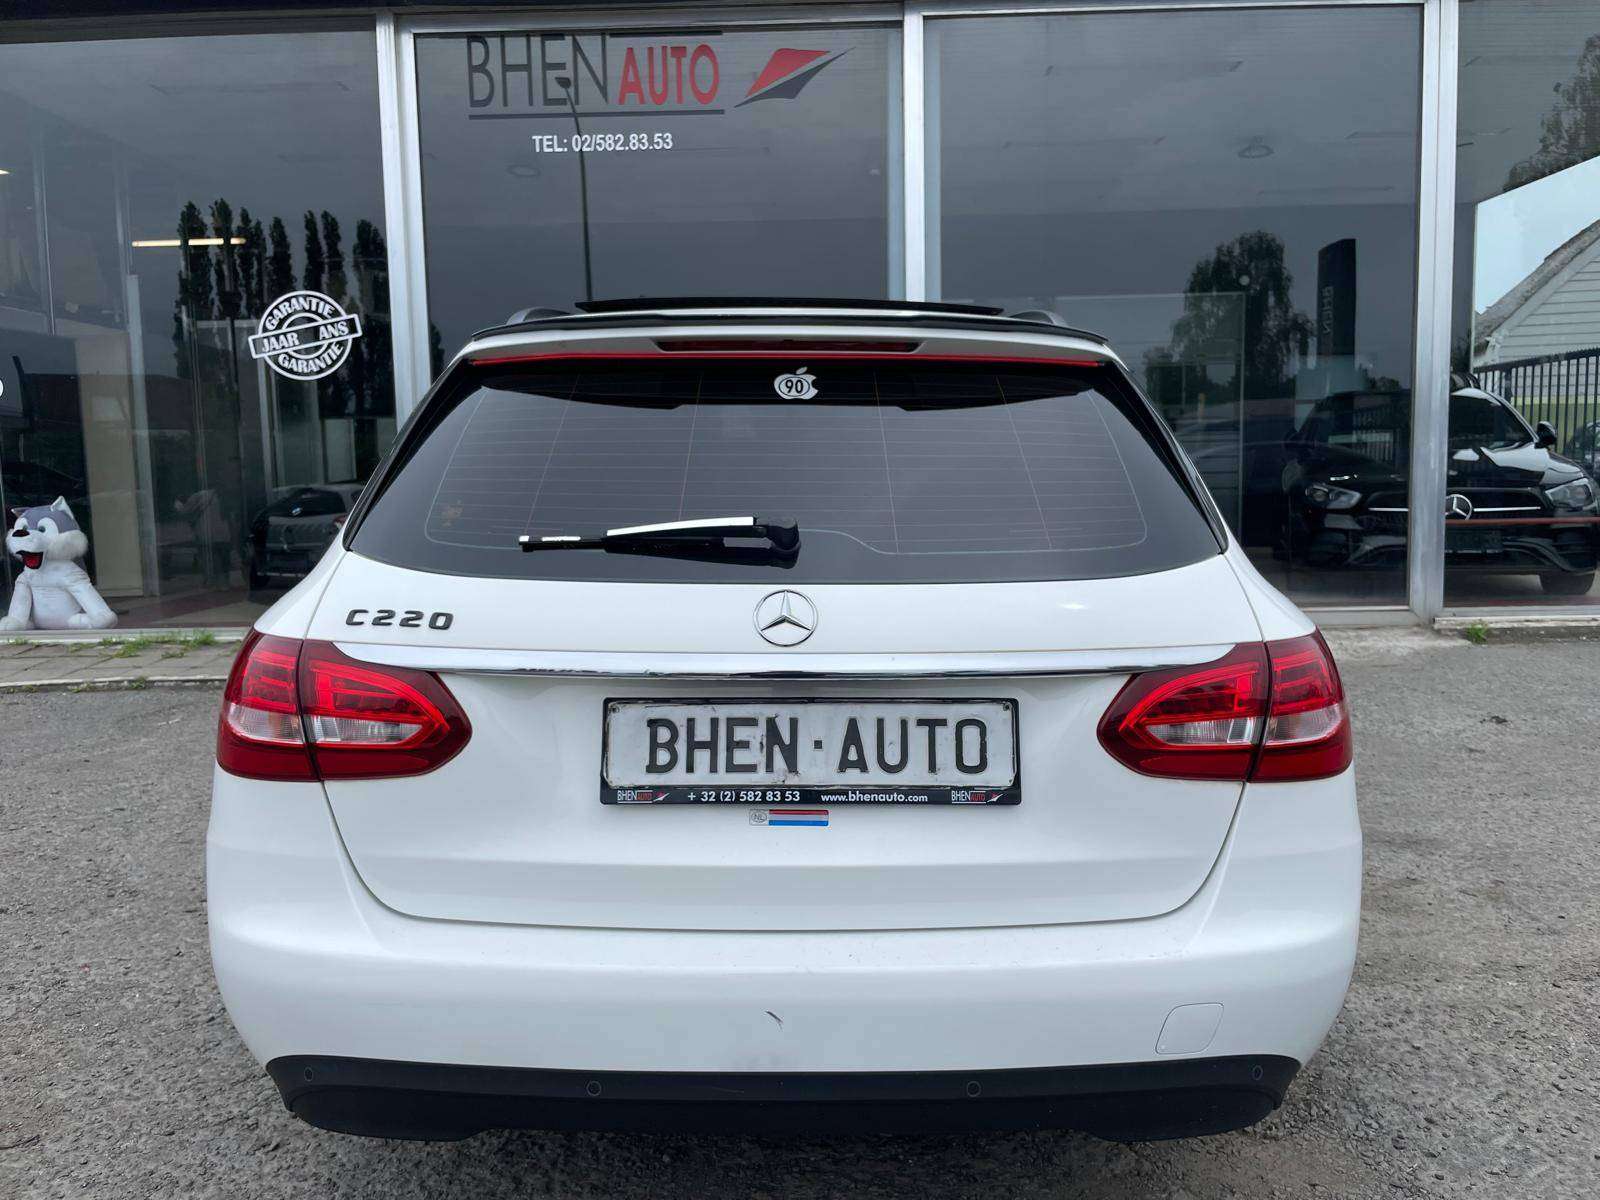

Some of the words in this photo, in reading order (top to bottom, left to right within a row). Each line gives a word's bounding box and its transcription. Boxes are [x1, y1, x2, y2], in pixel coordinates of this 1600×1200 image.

[532, 135, 567, 152] TEL:
[572, 133, 673, 152] 02/582.83.53
[265, 297, 335, 330] GARANTIE
[262, 332, 300, 352] JAAR
[320, 321, 349, 340] ANS
[278, 342, 344, 373] GARANTIE
[785, 379, 804, 394] 90
[345, 609, 454, 630] C220
[701, 790, 716, 801] 32
[720, 790, 735, 802] (2)
[740, 790, 762, 801] 582
[766, 790, 781, 801] 83
[785, 790, 800, 801] 53
[821, 790, 928, 803] www.bhenauto.com
